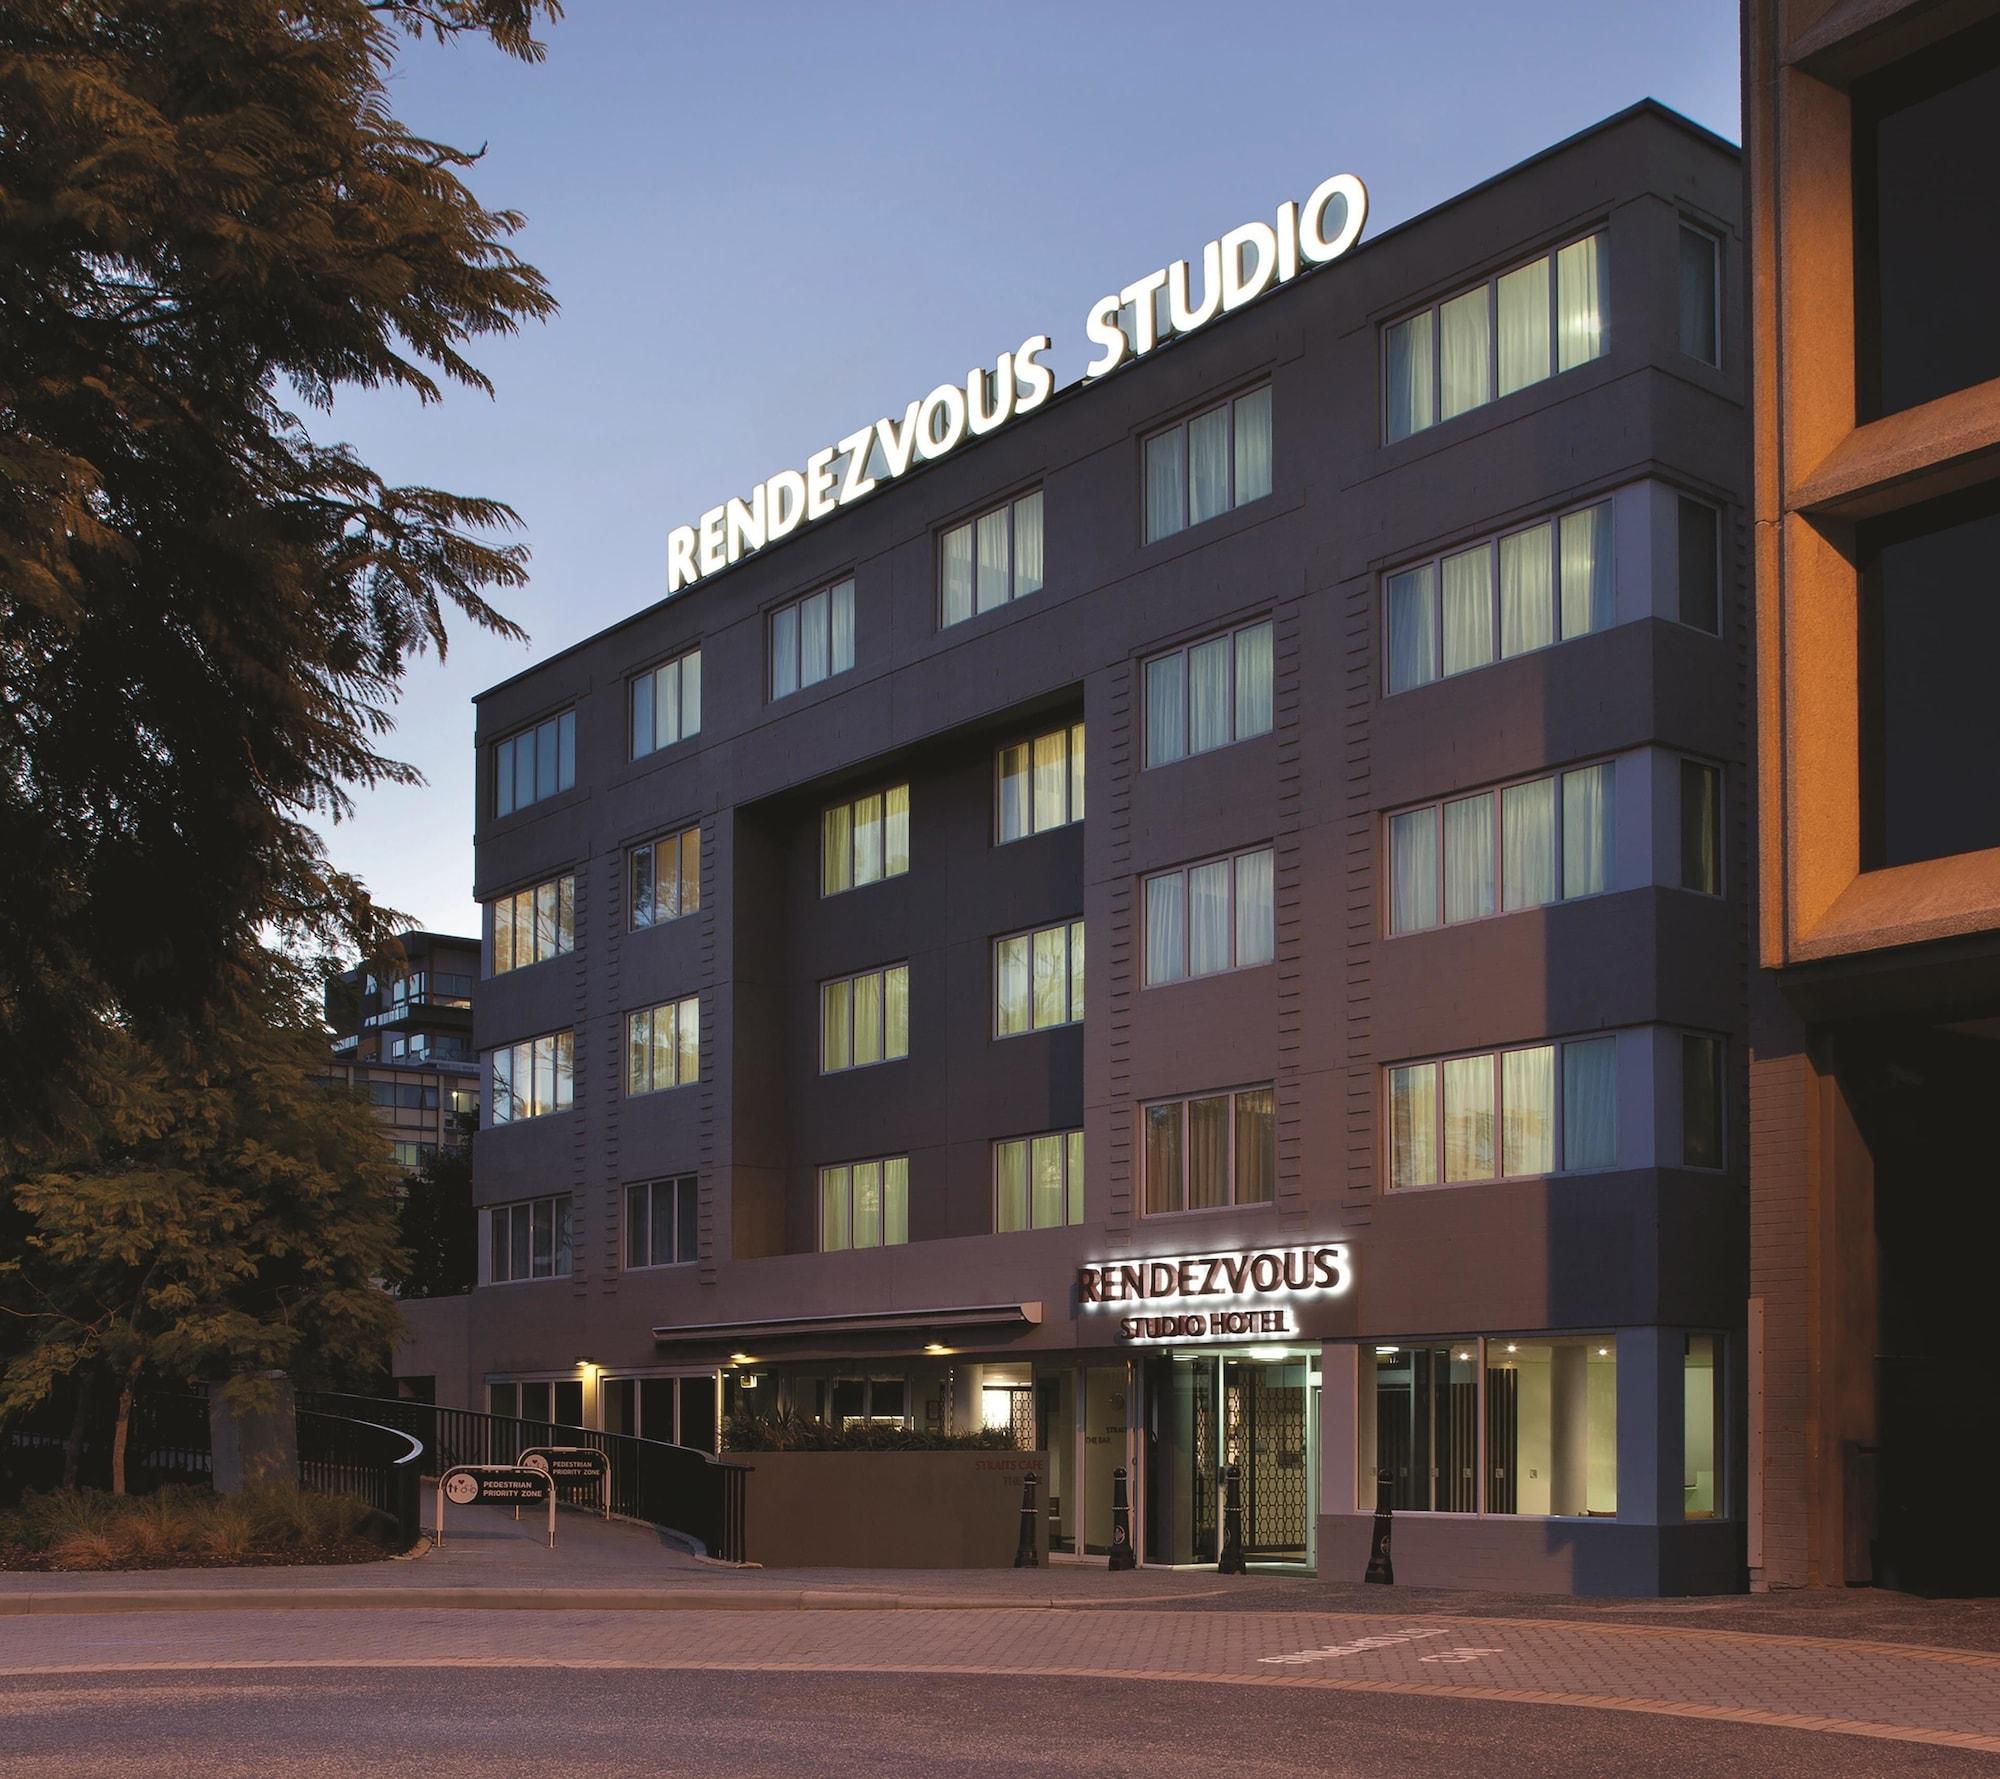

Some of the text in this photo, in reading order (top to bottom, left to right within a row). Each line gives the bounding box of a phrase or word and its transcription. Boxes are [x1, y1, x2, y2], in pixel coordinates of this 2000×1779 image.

[667, 172, 1369, 594] RENDEZVOUS STUDIO
[1078, 1249, 1340, 1303] RENDEZVOUS
[1120, 1310, 1290, 1340] STUDIO HOTEL
[483, 1481, 533, 1489] PEDESTRIAN
[483, 1489, 543, 1497] PRIORITY ZONE
